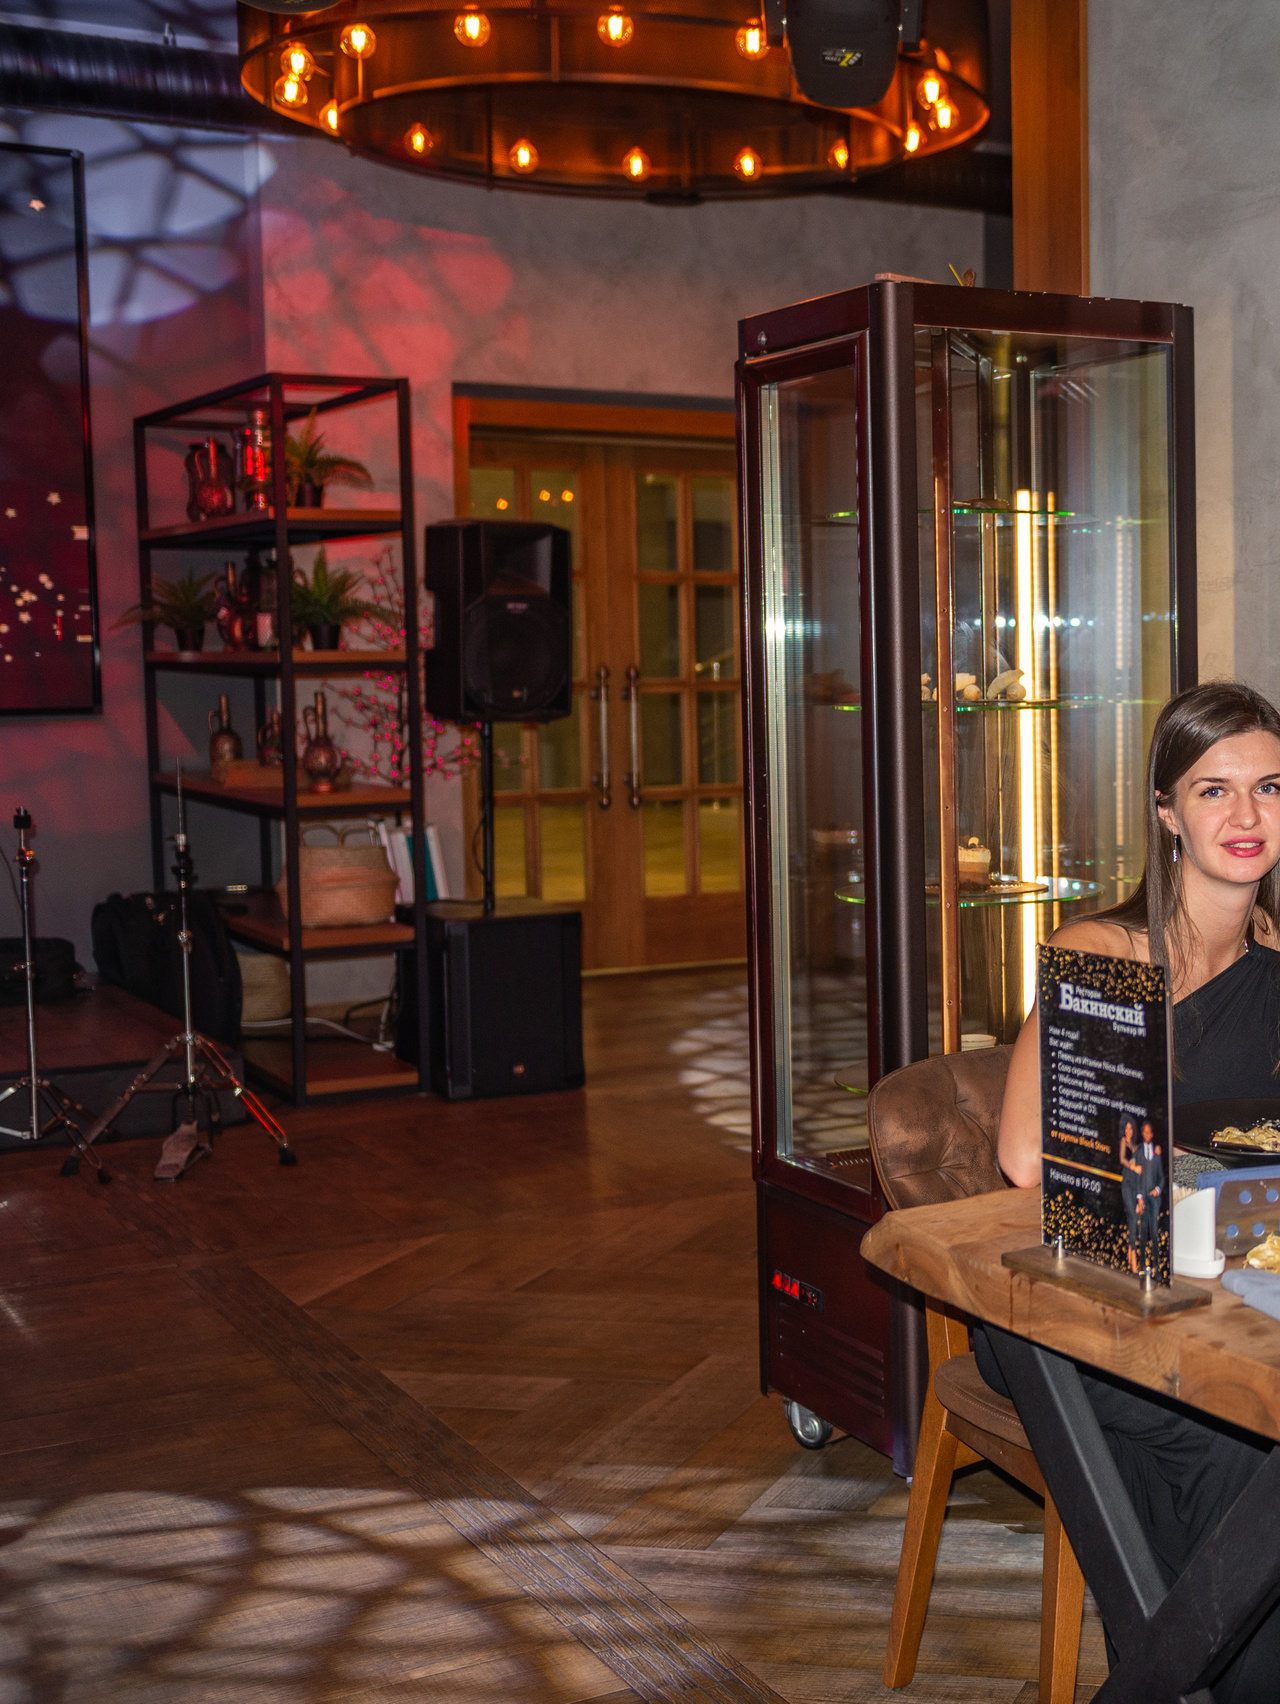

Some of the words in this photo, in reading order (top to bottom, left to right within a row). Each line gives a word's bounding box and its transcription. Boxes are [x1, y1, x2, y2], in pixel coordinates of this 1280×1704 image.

[1076, 985, 1102, 999] Ресторан
[1060, 982, 1144, 1026] Бакинский
[1113, 1021, 1136, 1036] Бульвар
[1058, 1050, 1074, 1063] Певец
[1082, 1056, 1102, 1068] Италии
[1058, 1062, 1072, 1073] Соло
[1058, 1072, 1082, 1088] Welcome
[1058, 1084, 1082, 1100] Сюрприз
[1083, 1092, 1090, 1100] от
[1090, 1095, 1110, 1107] нашего
[1058, 1096, 1082, 1111] Ведущий
[1050, 1130, 1058, 1138] от
[1058, 1132, 1078, 1144] группы
[1079, 1136, 1094, 1149] Black
[1050, 1168, 1074, 1186] Начало
[1076, 1178, 1081, 1188] в
